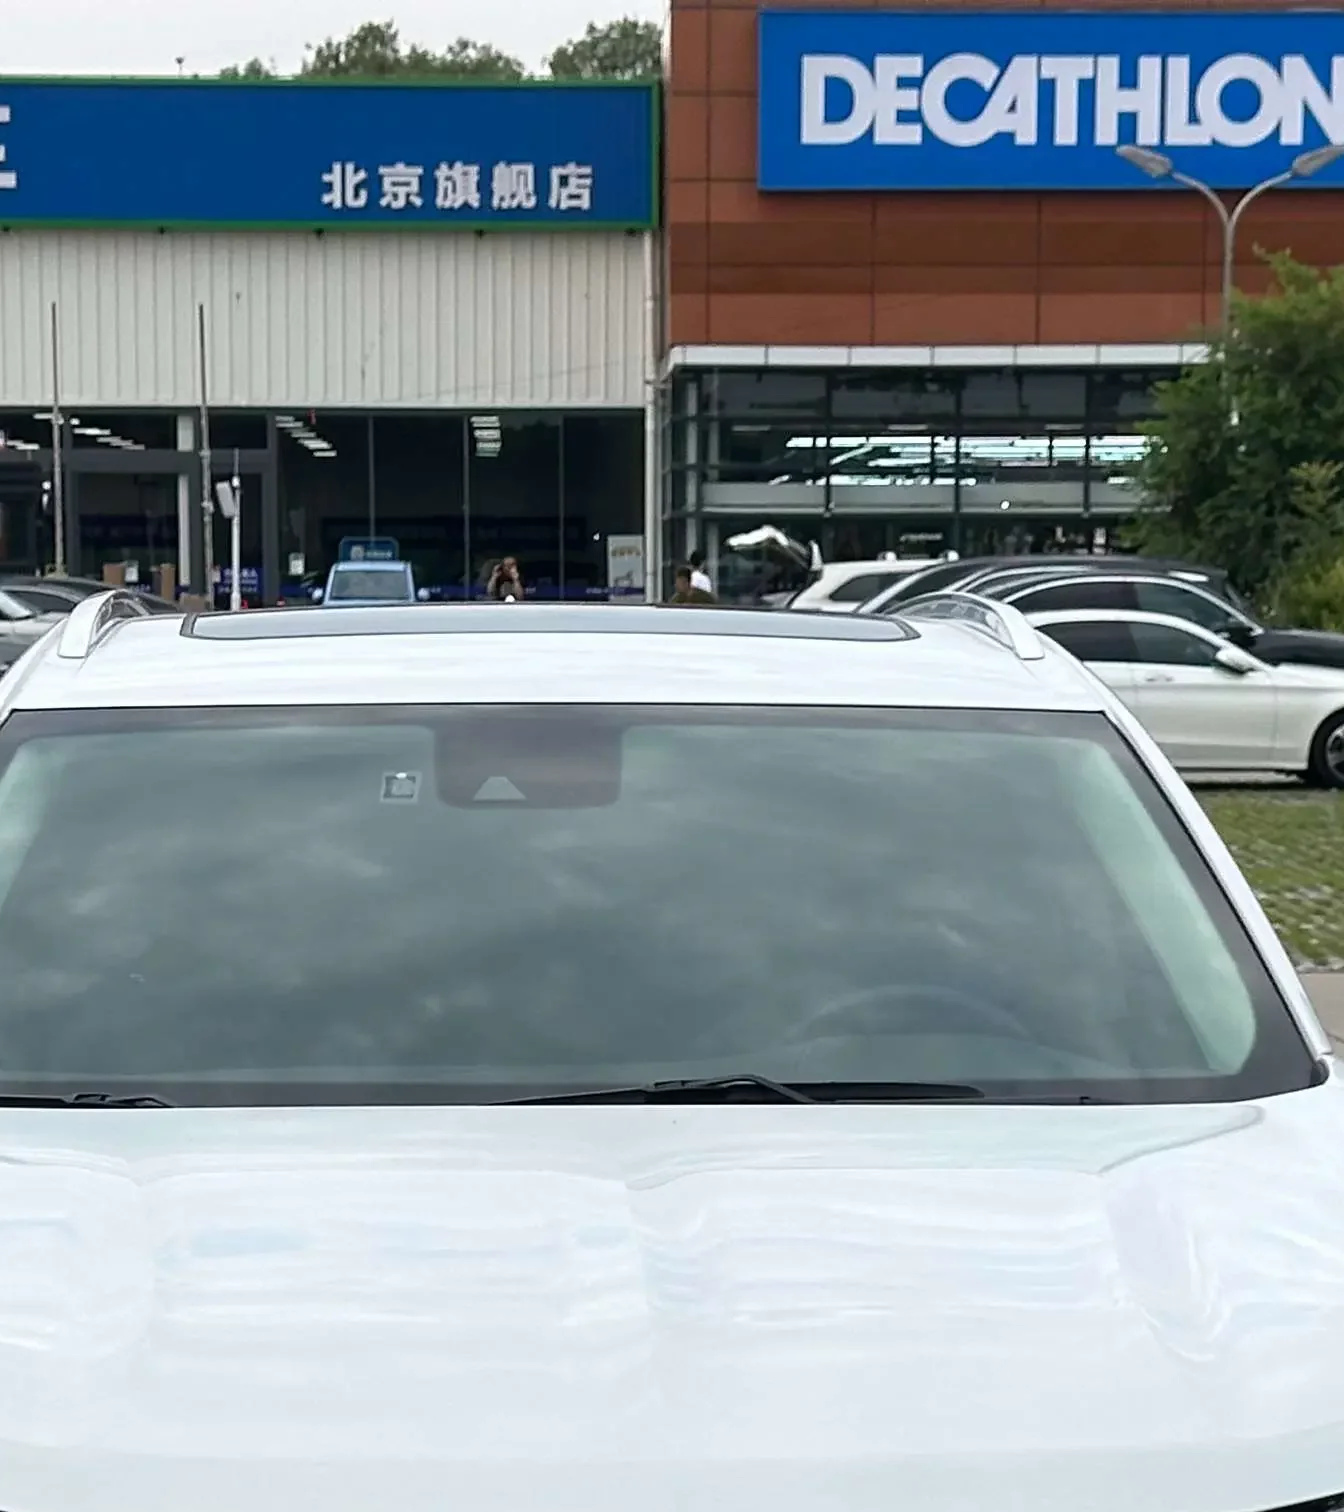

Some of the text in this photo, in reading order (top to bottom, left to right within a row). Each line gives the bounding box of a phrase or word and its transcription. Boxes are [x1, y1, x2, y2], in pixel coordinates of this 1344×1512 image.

[322, 162, 593, 210] 北京旗舰店
